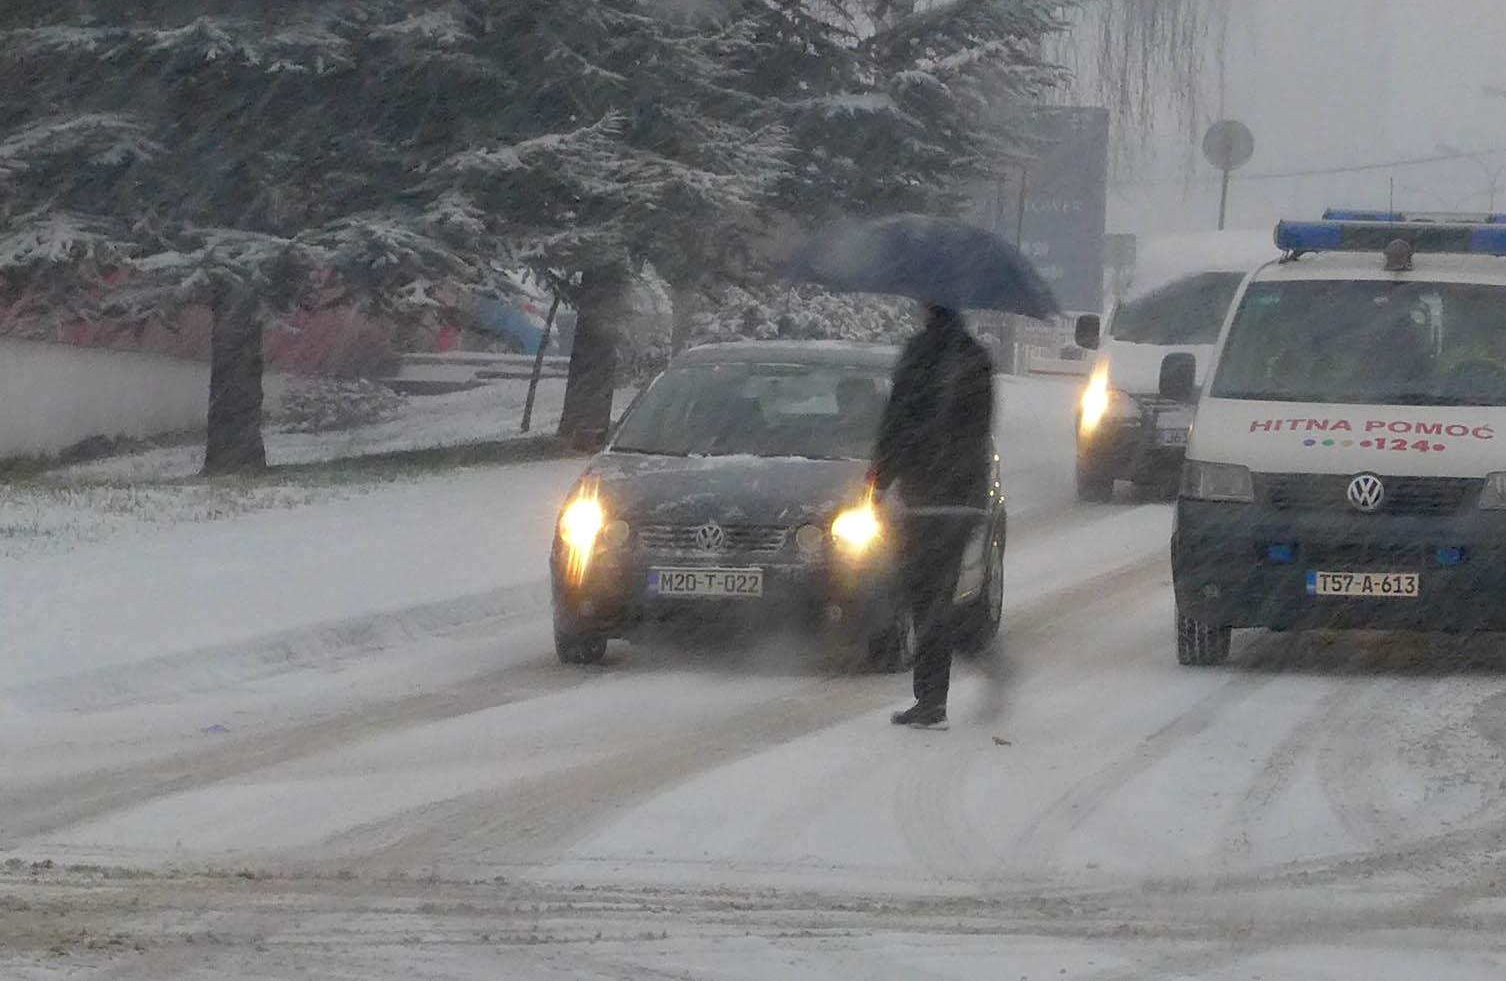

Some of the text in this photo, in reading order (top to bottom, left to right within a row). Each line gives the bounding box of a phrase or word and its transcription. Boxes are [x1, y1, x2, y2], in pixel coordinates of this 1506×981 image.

[1249, 418, 1495, 439] HITNA POMOĆ
[661, 573, 760, 593] M20-T-022
[1319, 574, 1416, 594] T57-A-613
